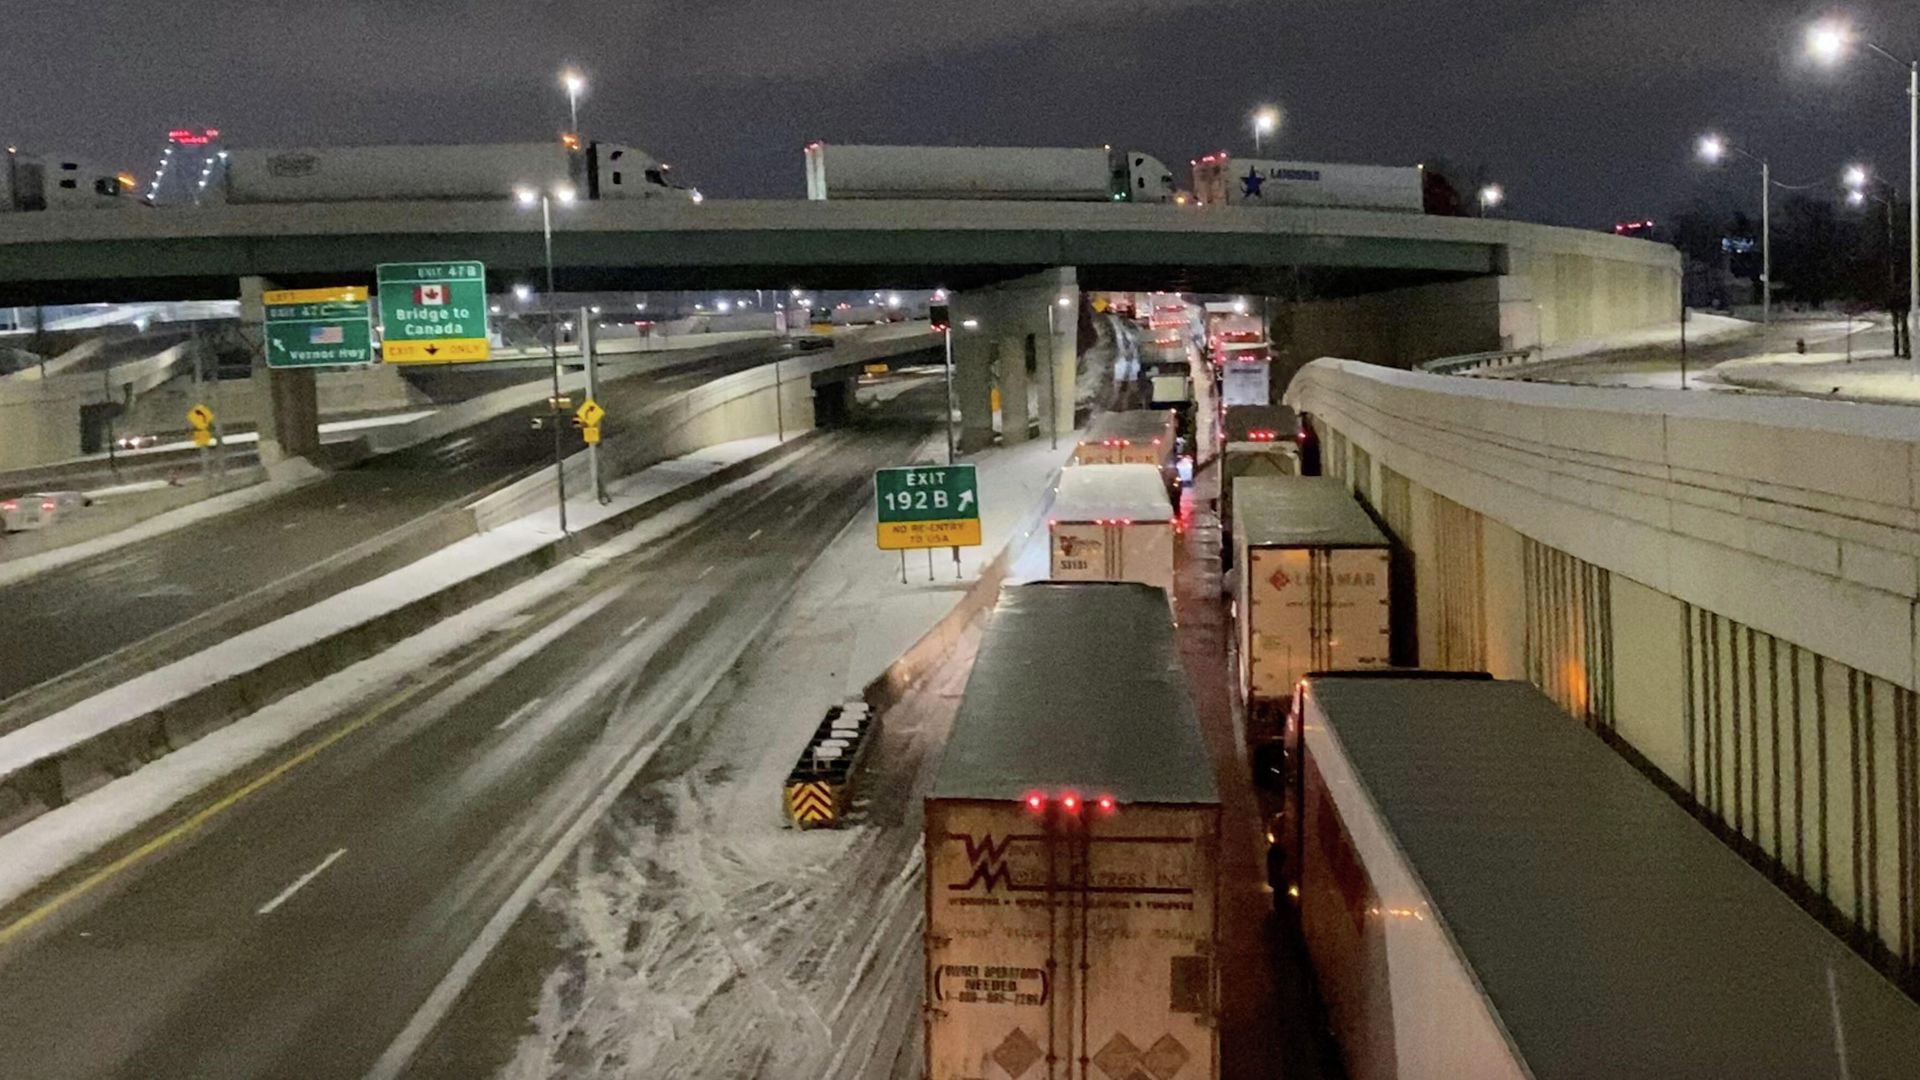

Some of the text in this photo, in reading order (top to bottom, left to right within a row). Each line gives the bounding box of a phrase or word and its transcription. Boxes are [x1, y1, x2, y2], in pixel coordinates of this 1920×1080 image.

[418, 265, 477, 278] EXIT 47B
[269, 307, 296, 317] EXIT
[396, 306, 470, 323] Bridge to
[404, 321, 464, 336] Canada
[338, 348, 366, 360] Hwy
[388, 343, 480, 356] EXIT ONLY
[906, 472, 946, 486] EXIT
[884, 489, 949, 511] 192B
[892, 522, 965, 533] NO RE-ENTRY
[910, 534, 950, 544] TO USA
[965, 979, 1017, 991] NEEDED
